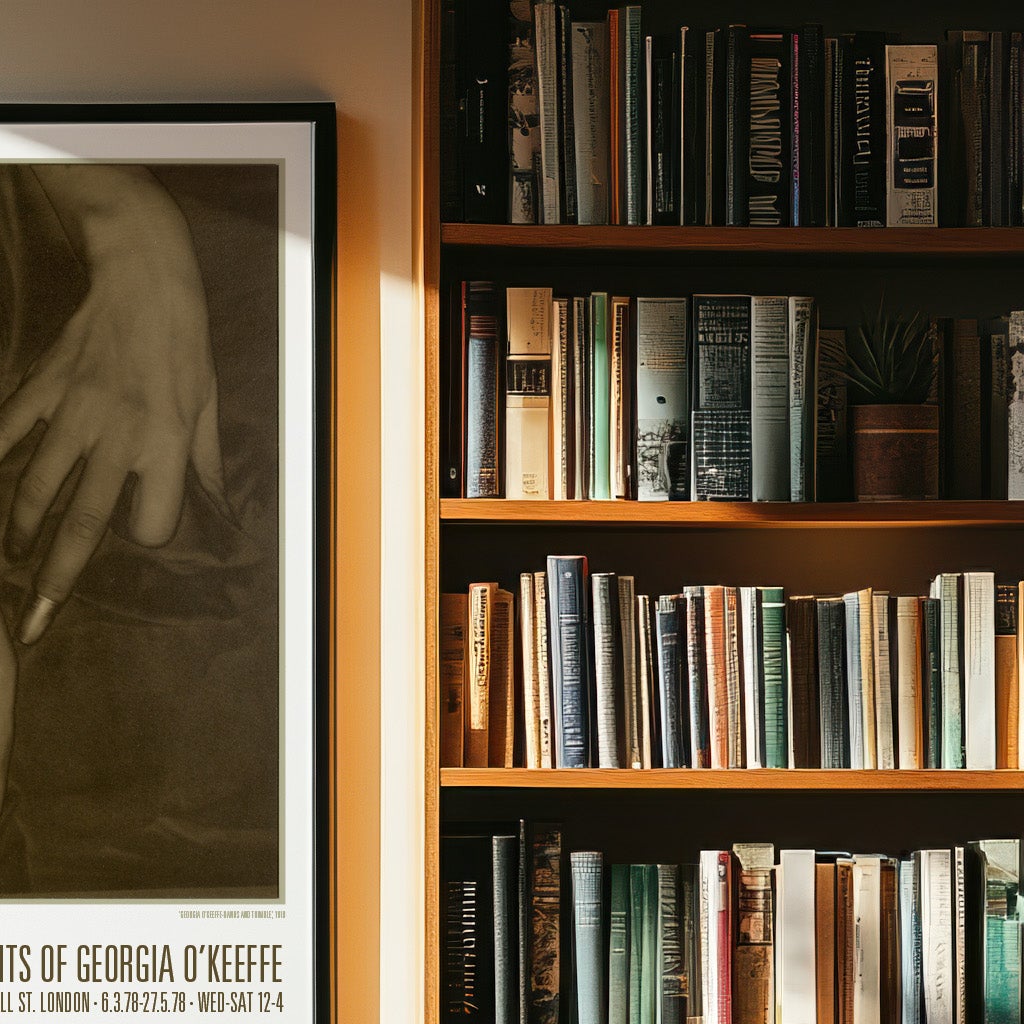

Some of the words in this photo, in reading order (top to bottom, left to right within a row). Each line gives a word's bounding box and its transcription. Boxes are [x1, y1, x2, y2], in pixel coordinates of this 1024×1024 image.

[41, 944, 68, 983] OF
[77, 944, 175, 983] GEORGIA
[184, 944, 283, 983] O'KEEFFE
[18, 991, 36, 1013] ST.
[40, 991, 90, 1013] LONDON
[101, 991, 186, 1013] 6.3.78-27.5.78
[197, 991, 254, 1013] WED-SAT
[258, 991, 285, 1013] 12-4
